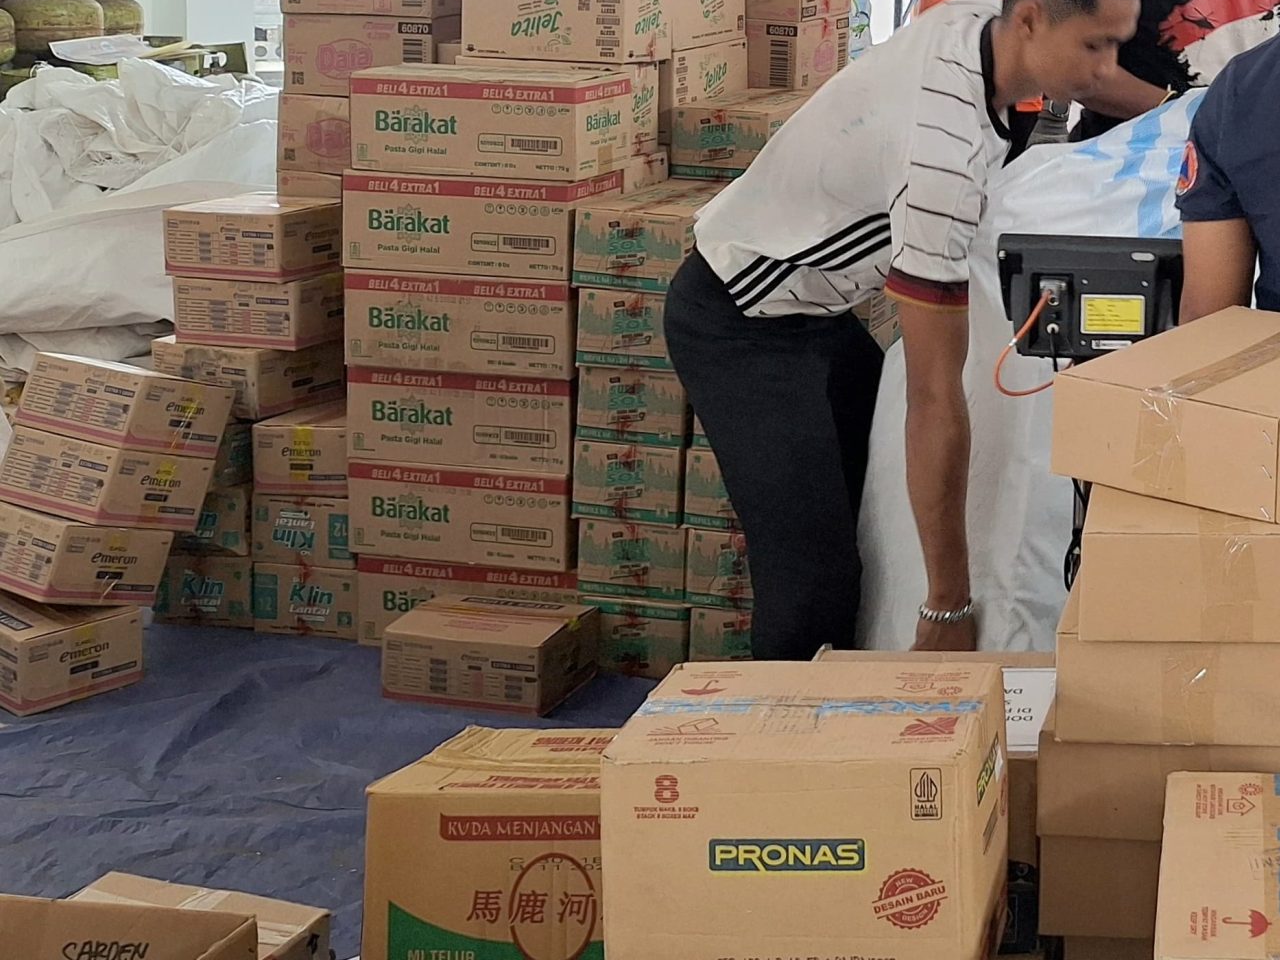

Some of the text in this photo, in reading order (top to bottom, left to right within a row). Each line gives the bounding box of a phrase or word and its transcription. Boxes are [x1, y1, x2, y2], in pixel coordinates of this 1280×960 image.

[401, 24, 429, 33] 60870
[511, 10, 563, 38] Jelita
[635, 9, 663, 36] Jelita
[769, 26, 795, 35] 60870
[318, 44, 372, 73] Daia
[704, 61, 728, 92] Jelita
[632, 85, 654, 113] Jelita
[375, 110, 457, 135] Bärakat
[385, 144, 447, 155] Pasta Gigi Halal
[368, 209, 450, 234] Bärakat
[377, 243, 440, 254] Pasta Gigi Halal
[368, 306, 450, 332] Bärakat
[378, 341, 440, 352] Pasta Gigi Halal
[371, 400, 453, 426] Bärakat
[381, 434, 402, 443] Pasta
[423, 436, 443, 445] Halal
[371, 496, 450, 523] Bärakat
[91, 553, 138, 566] emeron
[290, 584, 333, 605] Klin
[289, 604, 329, 615] Lantai
[60, 642, 110, 663] emeron
[654, 775, 680, 803] 8
[448, 821, 596, 837] KUDA MENJANGAN
[714, 844, 860, 872] PRONAS
[895, 877, 914, 887] NEW
[873, 884, 947, 915] DESAIN BARU
[901, 909, 929, 923] DESIGN
